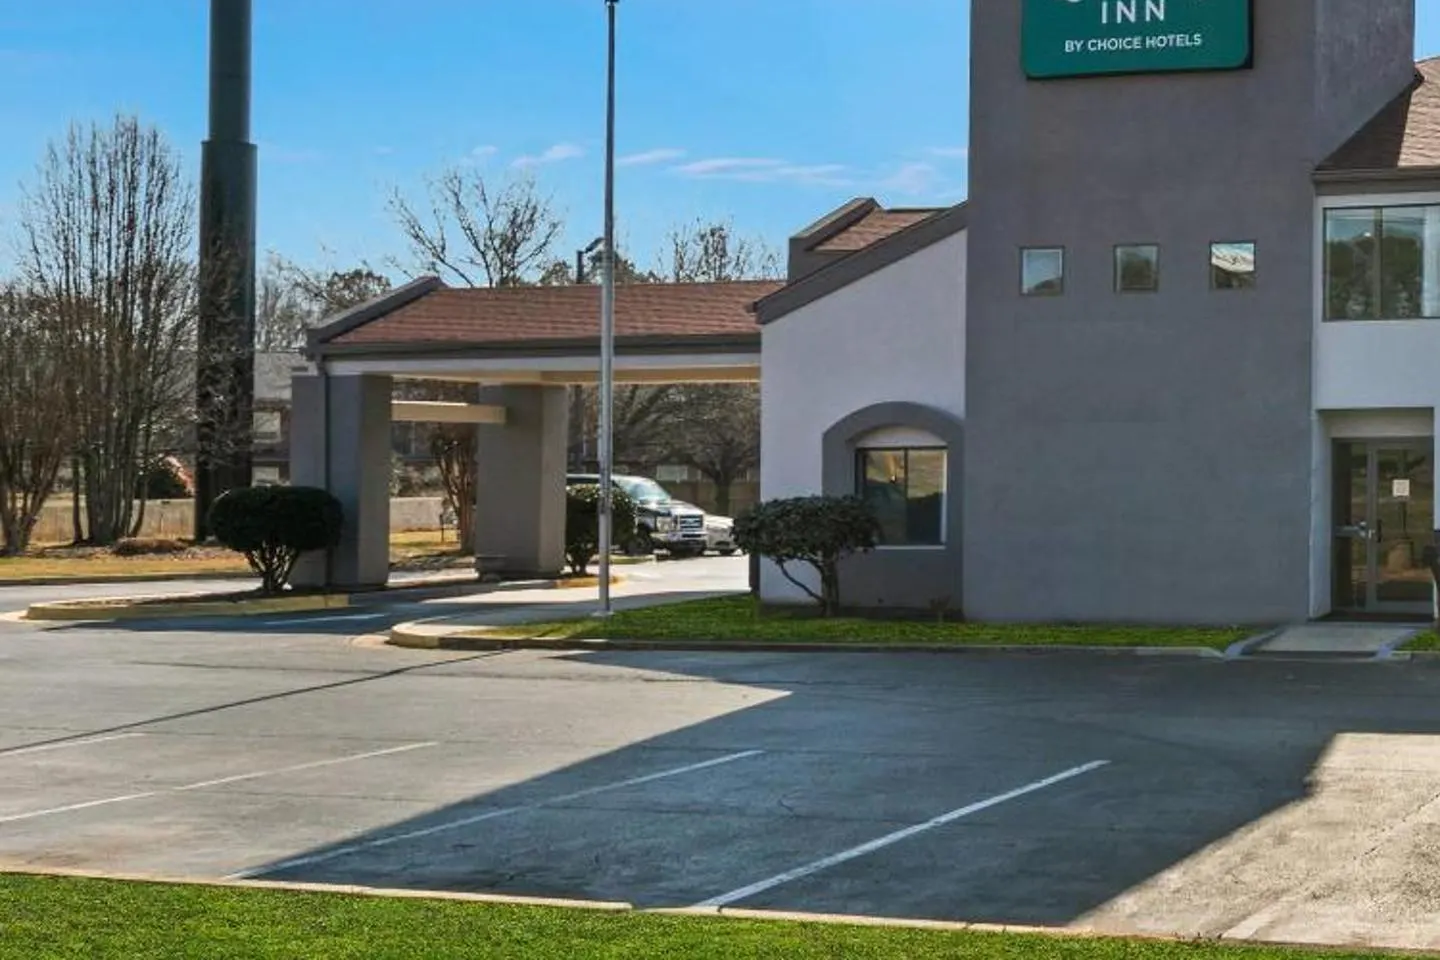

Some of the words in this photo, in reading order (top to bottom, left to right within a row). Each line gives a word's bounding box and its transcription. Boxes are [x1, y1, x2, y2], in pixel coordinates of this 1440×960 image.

[1064, 39, 1082, 53] BY
[1087, 36, 1142, 52] CHOICE
[1146, 33, 1202, 49] HOTELS
